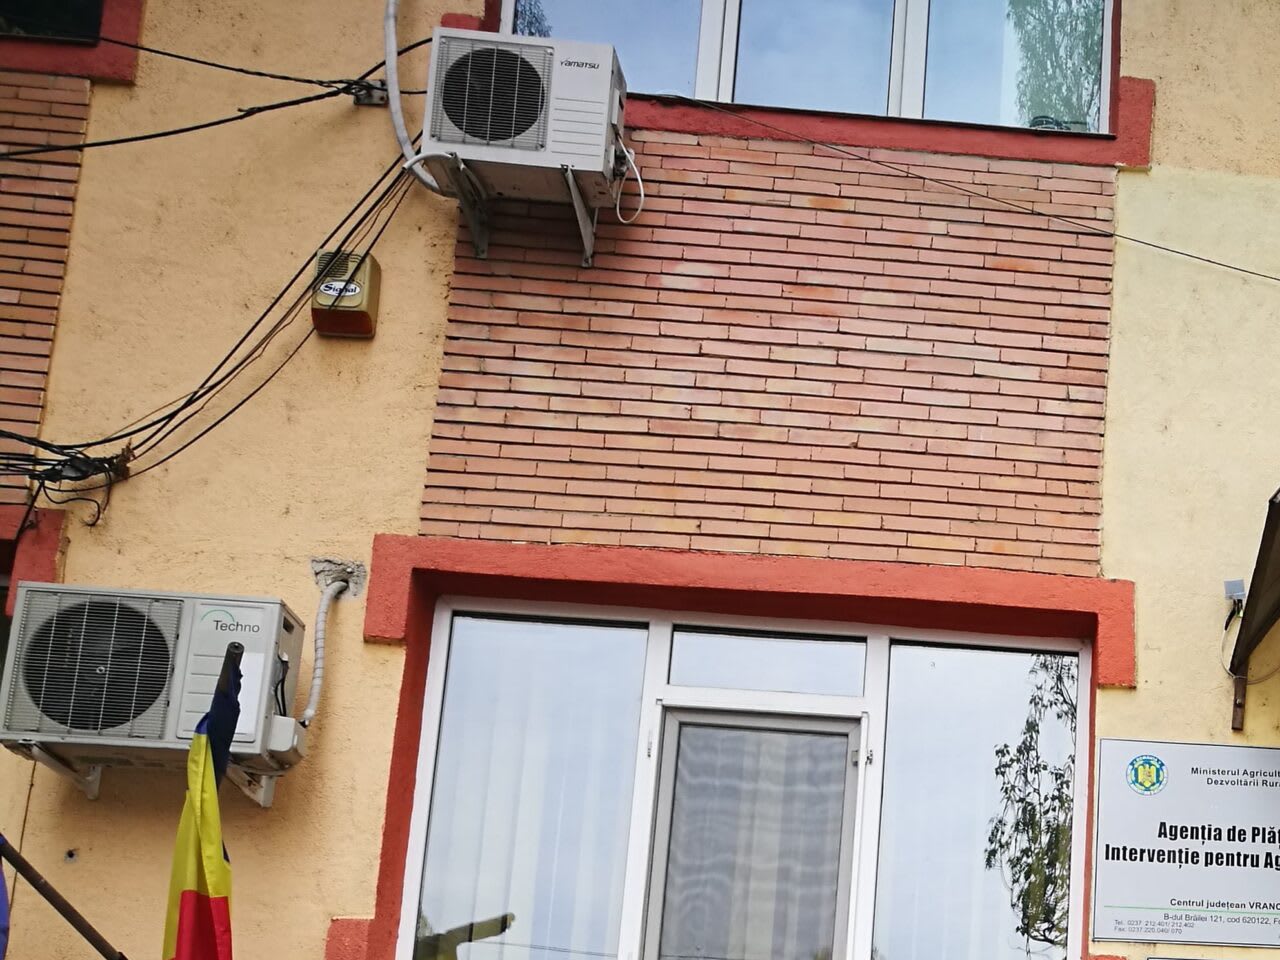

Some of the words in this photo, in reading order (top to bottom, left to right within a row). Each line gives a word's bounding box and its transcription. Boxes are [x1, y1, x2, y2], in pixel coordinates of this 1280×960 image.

[214, 620, 260, 633] Techno
[1191, 767, 1240, 776] Ministerul
[1206, 778, 1259, 787] Dezvoltării
[1227, 826, 1247, 842] de
[1204, 850, 1259, 867] pentru
[1170, 898, 1204, 908] Centrul
[1164, 913, 1183, 921] B-dul
[1210, 915, 1225, 923] 121,
[1242, 917, 1271, 925] 620122,
